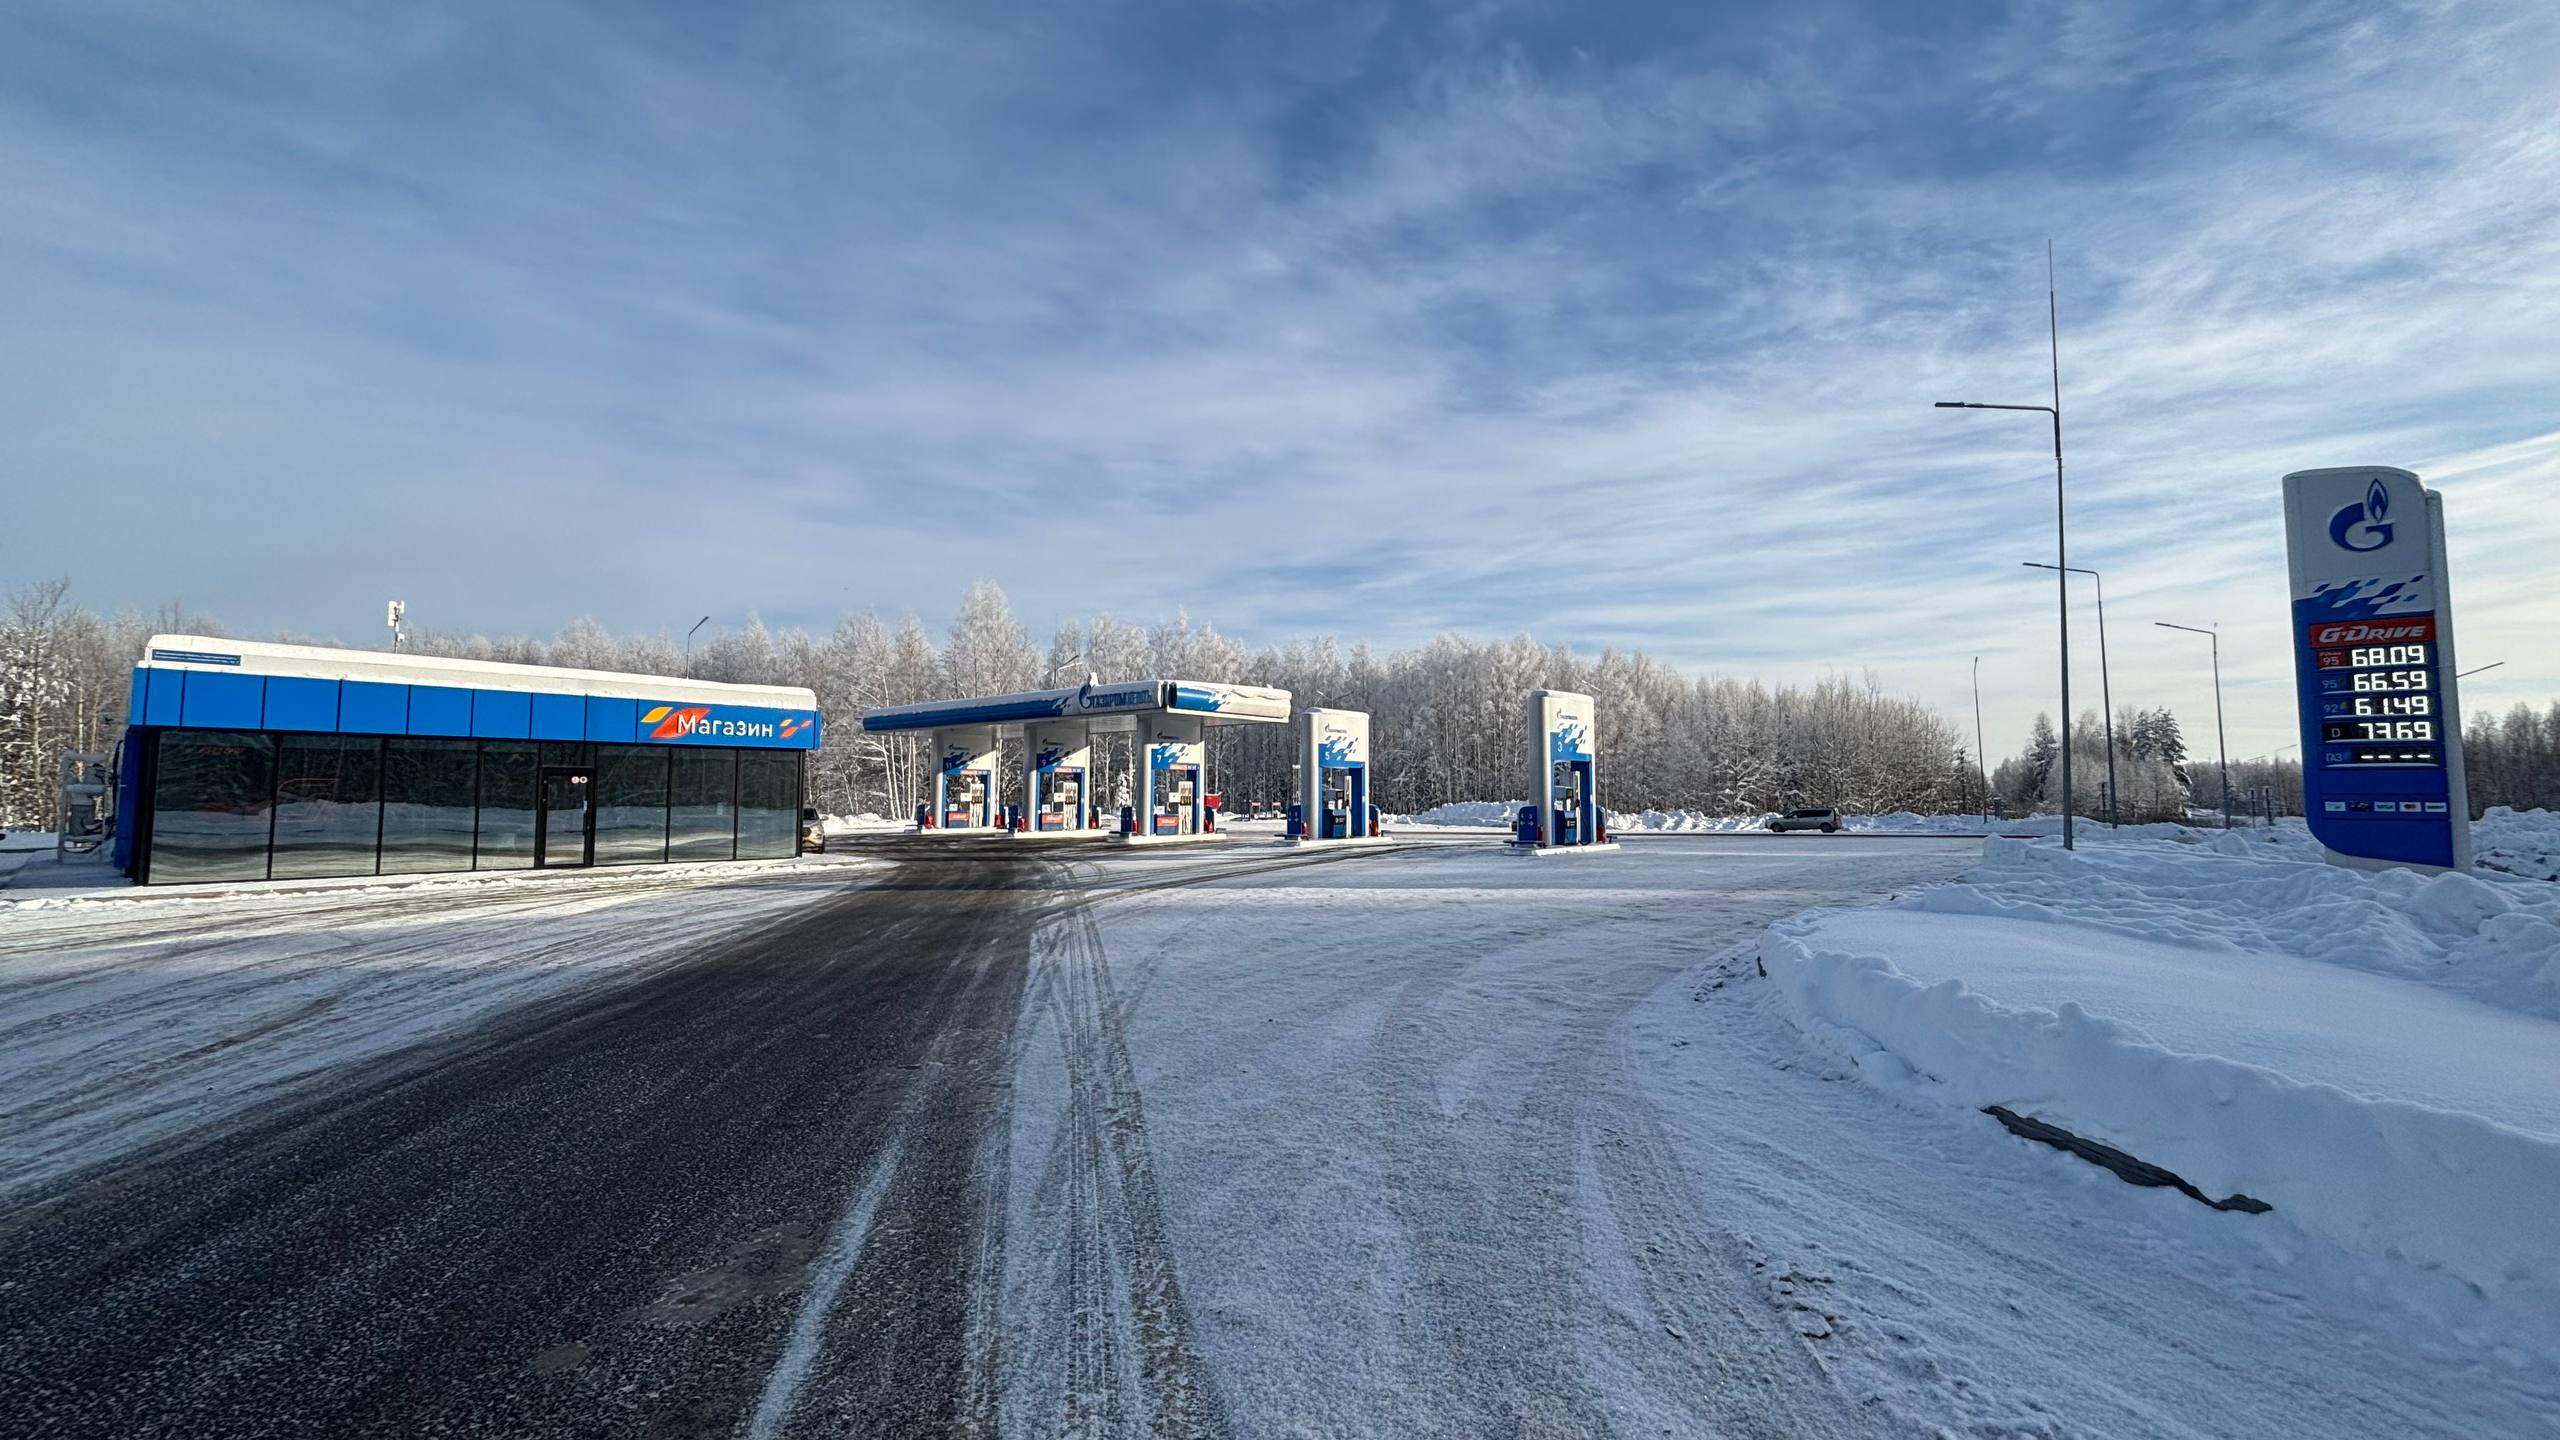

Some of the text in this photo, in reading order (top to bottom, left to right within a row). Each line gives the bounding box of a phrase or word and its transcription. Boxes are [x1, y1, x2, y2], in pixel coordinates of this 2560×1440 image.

[2323, 645, 2425, 667] 95 68.09
[2321, 670, 2427, 692] 95 66.59
[2323, 695, 2429, 716] 92 61.49
[676, 714, 773, 738] Магазин
[2331, 728, 2341, 738] D
[1324, 751, 1330, 761] 5
[1557, 741, 1563, 753] 3
